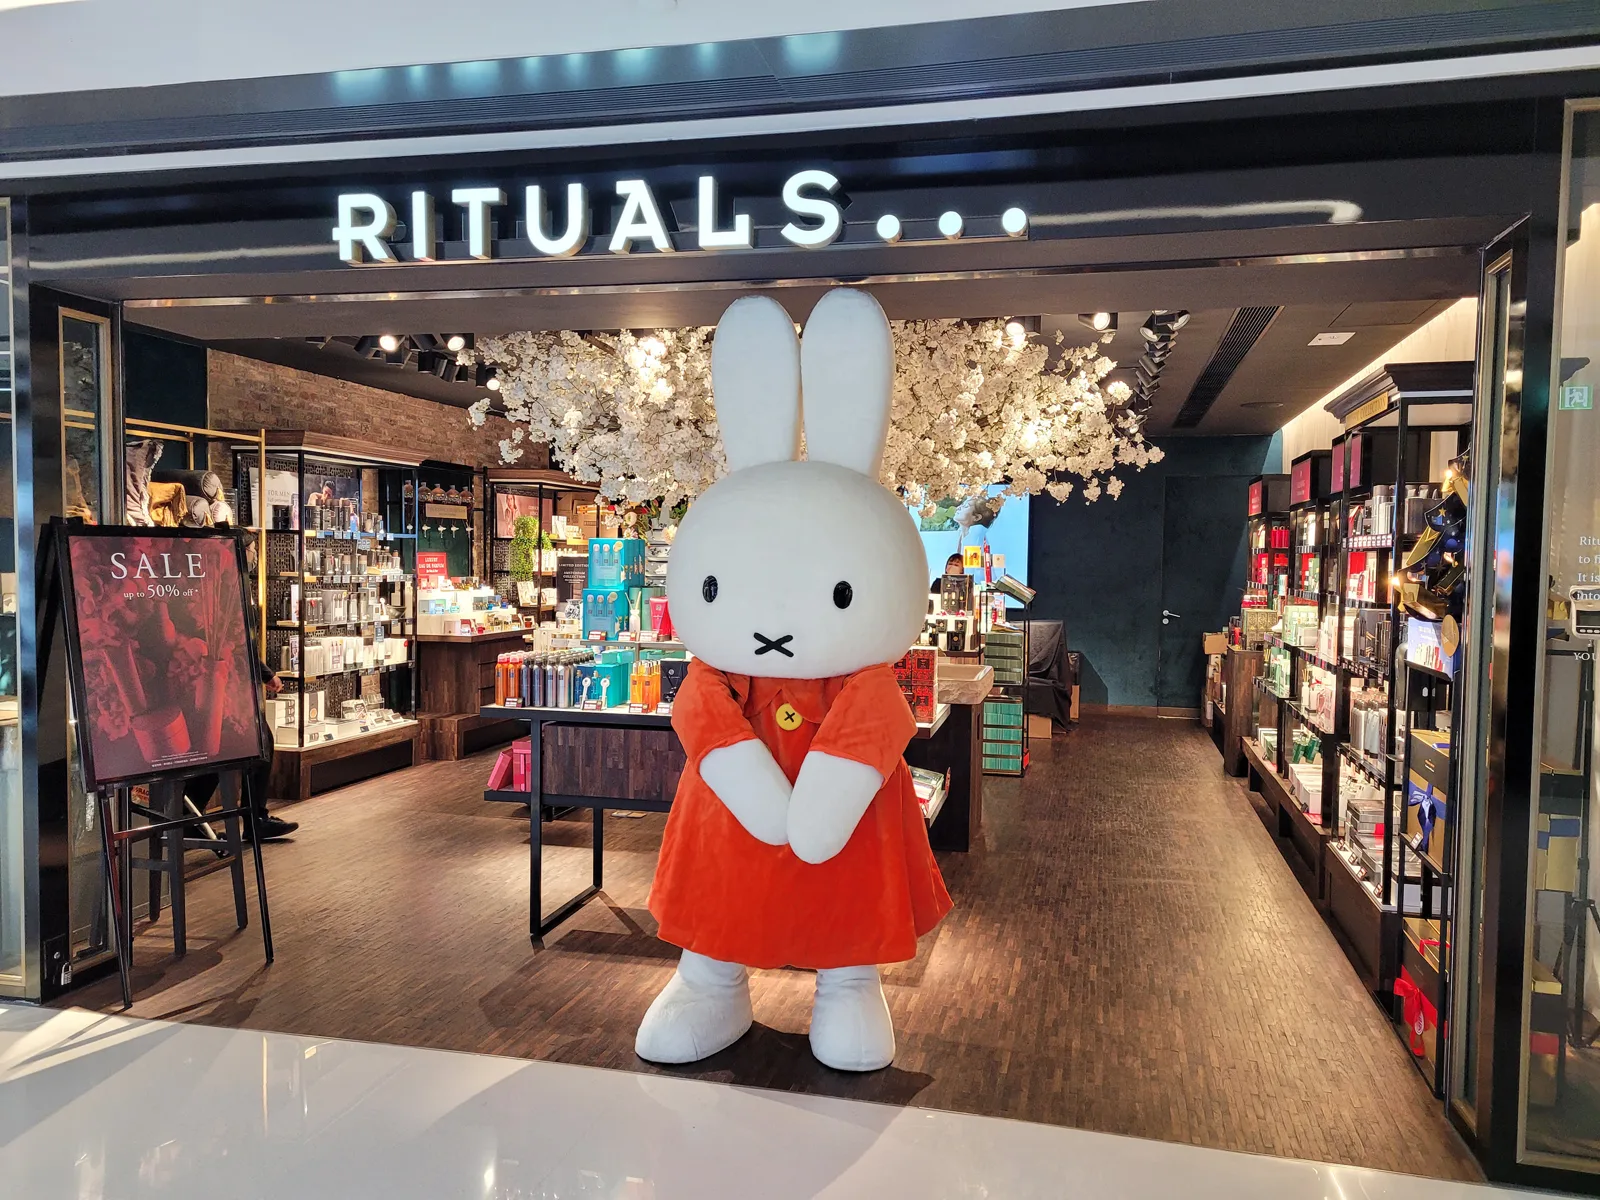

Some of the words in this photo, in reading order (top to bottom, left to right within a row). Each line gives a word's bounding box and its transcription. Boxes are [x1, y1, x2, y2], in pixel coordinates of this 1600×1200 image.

[1578, 555, 1591, 564] to
[110, 552, 206, 580] SALE
[1577, 572, 1586, 583] It
[123, 592, 134, 600] up
[136, 590, 145, 598] to
[147, 584, 180, 599] 50%
[1576, 590, 1600, 601] into
